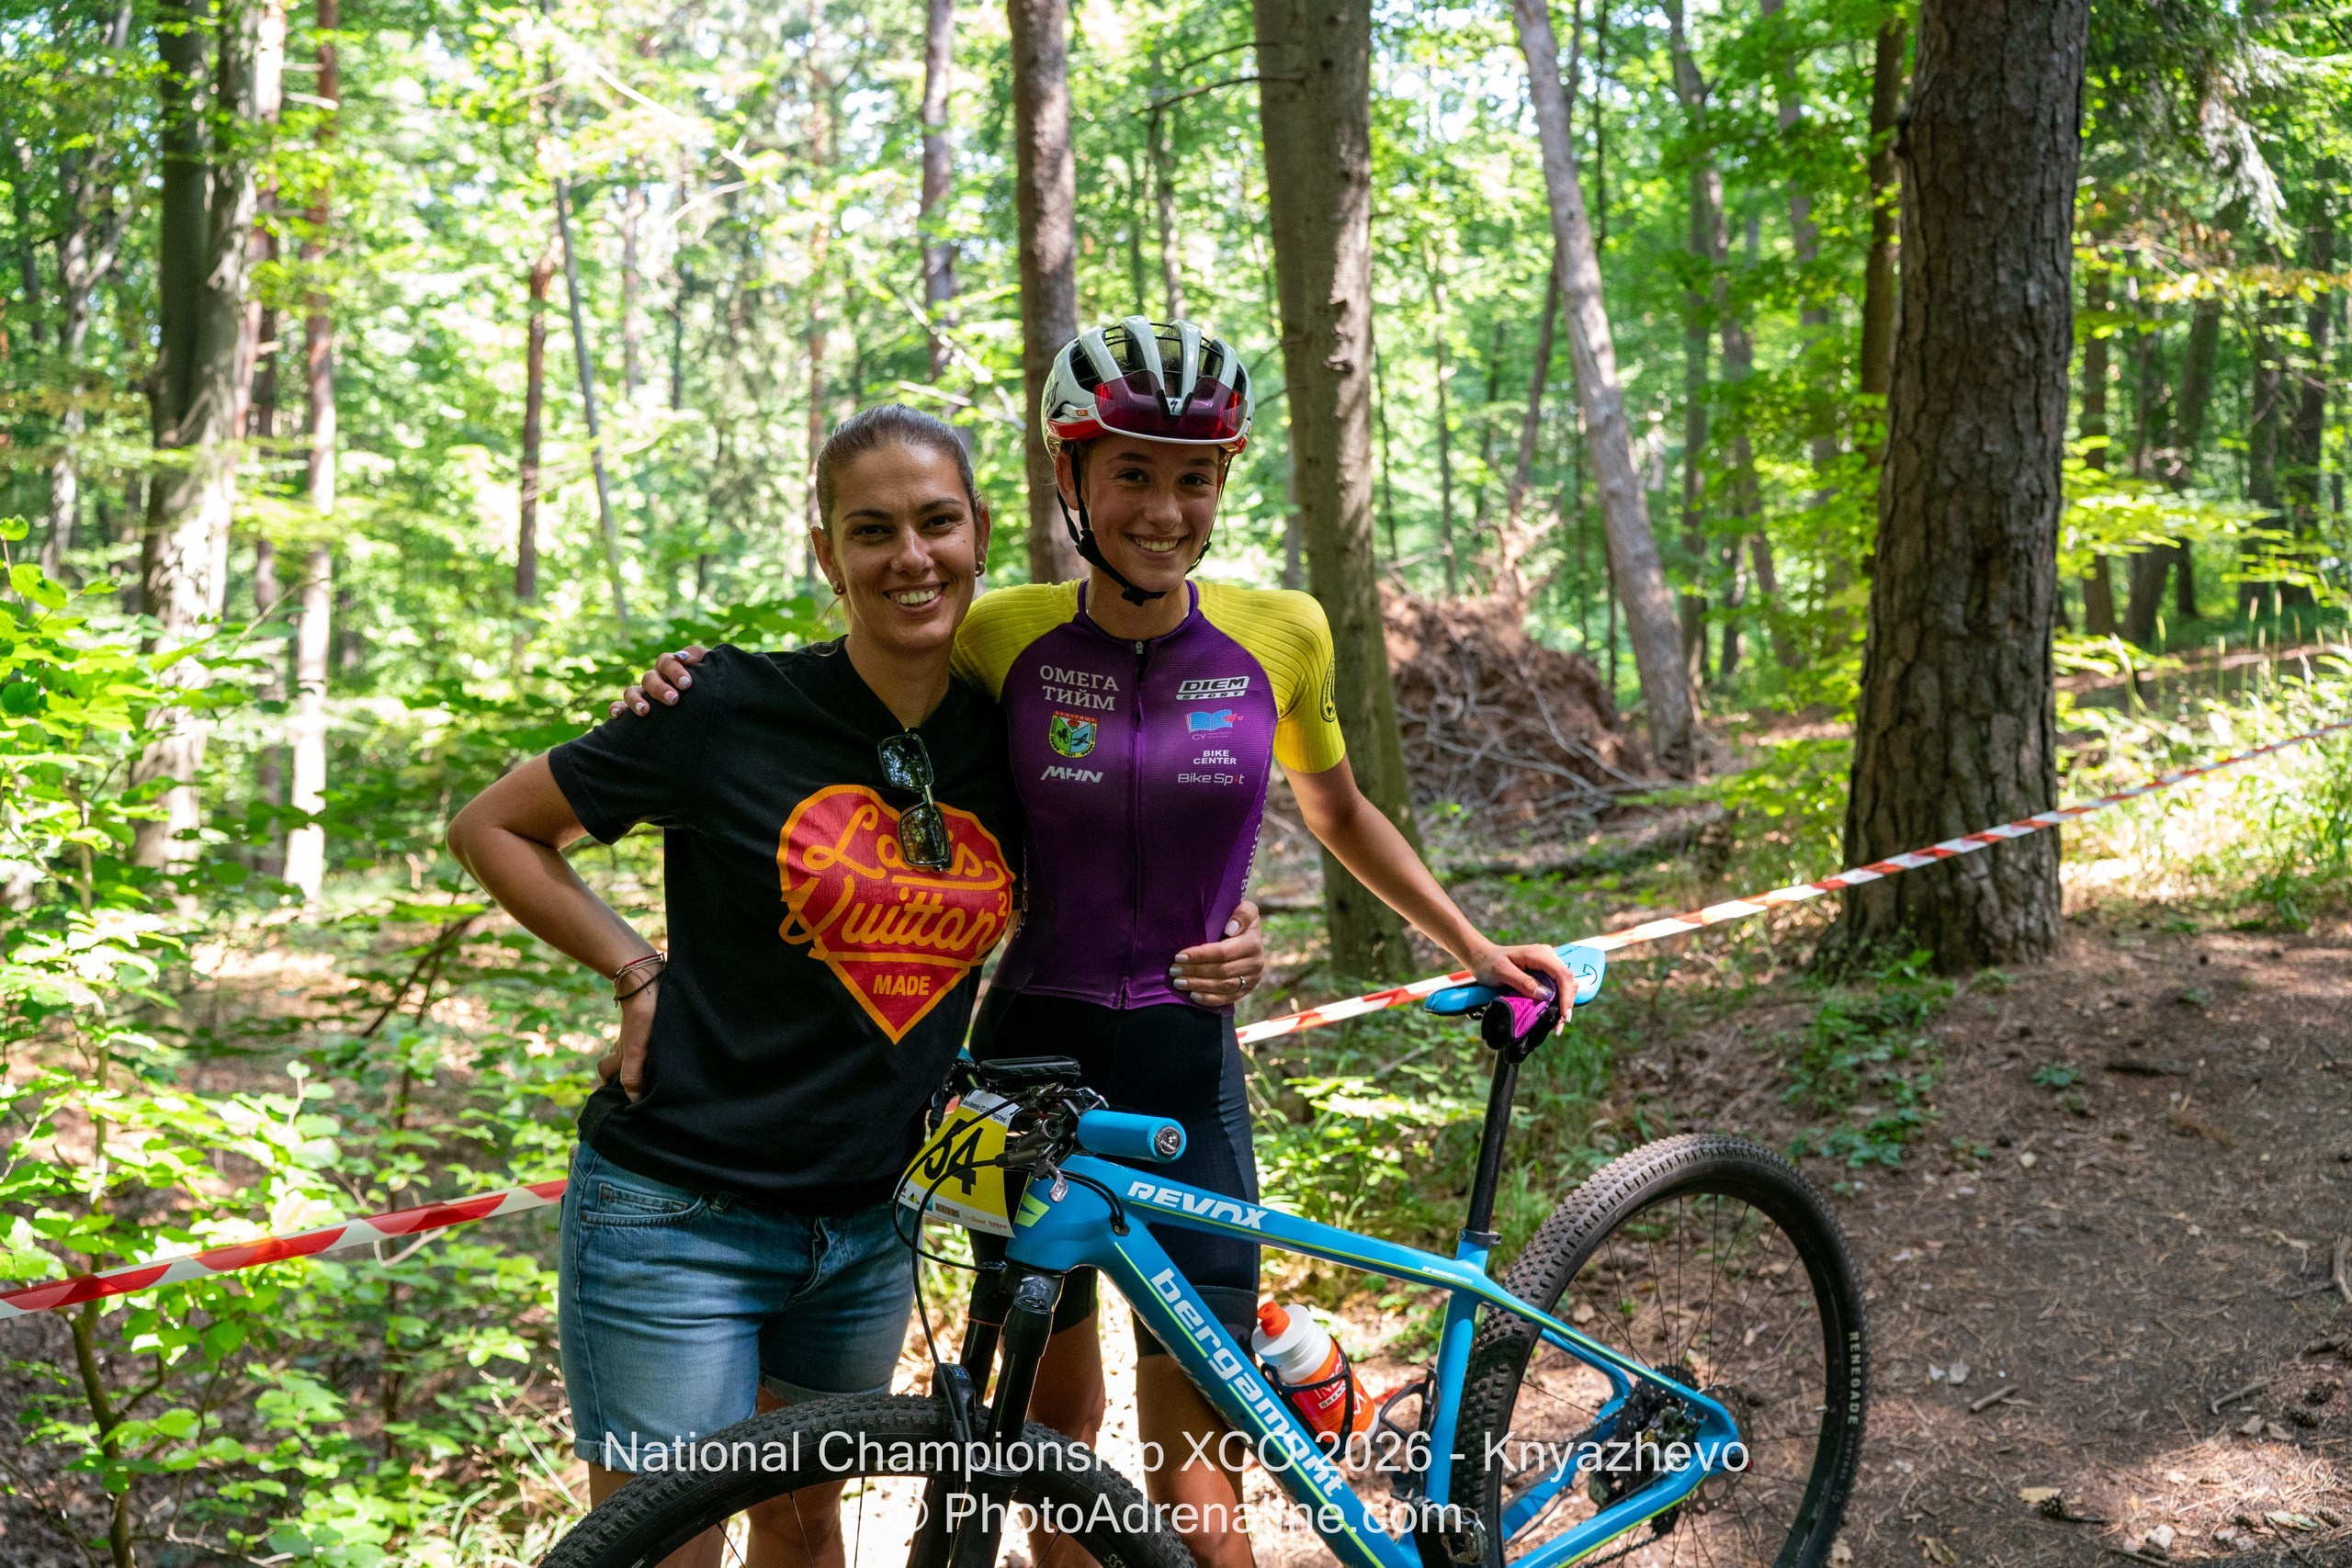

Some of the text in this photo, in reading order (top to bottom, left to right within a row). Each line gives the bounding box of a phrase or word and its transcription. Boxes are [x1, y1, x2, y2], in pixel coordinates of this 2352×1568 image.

[1040, 665, 1119, 691] ОМЕГА
[1182, 677, 1246, 691] DIEM
[1043, 685, 1115, 711] ТИЙМ
[1182, 691, 1241, 700] SPORT
[1040, 766, 1102, 783] MHN
[1178, 773, 1212, 783] Bike
[802, 804, 983, 879] Los
[873, 975, 931, 996] MADE
[1150, 1267, 1344, 1497] bergamont
[1847, 1331, 1862, 1426] RENEGADE
